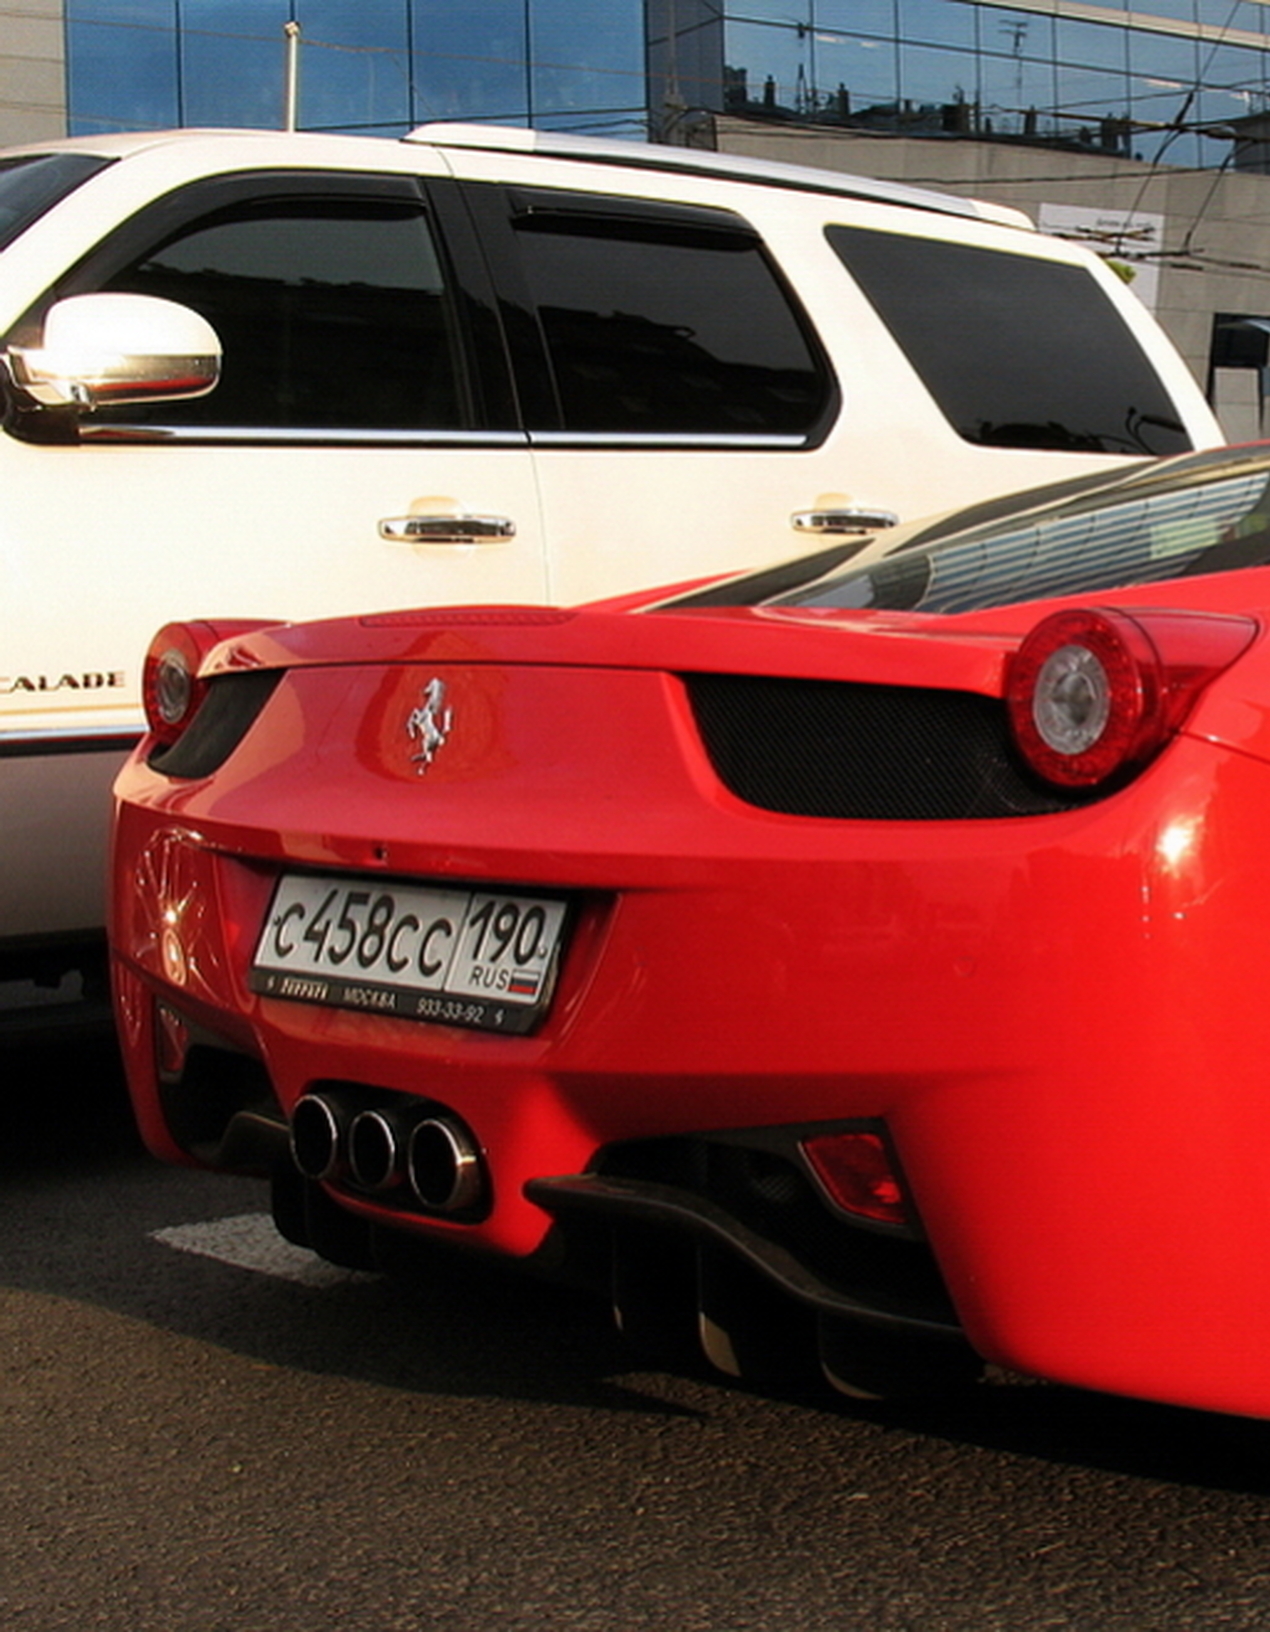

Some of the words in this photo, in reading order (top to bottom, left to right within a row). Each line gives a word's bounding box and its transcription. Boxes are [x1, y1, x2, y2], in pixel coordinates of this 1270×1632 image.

[469, 901, 547, 966] 190
[469, 965, 509, 990] RUS
[416, 998, 484, 1024] 933-33-92
